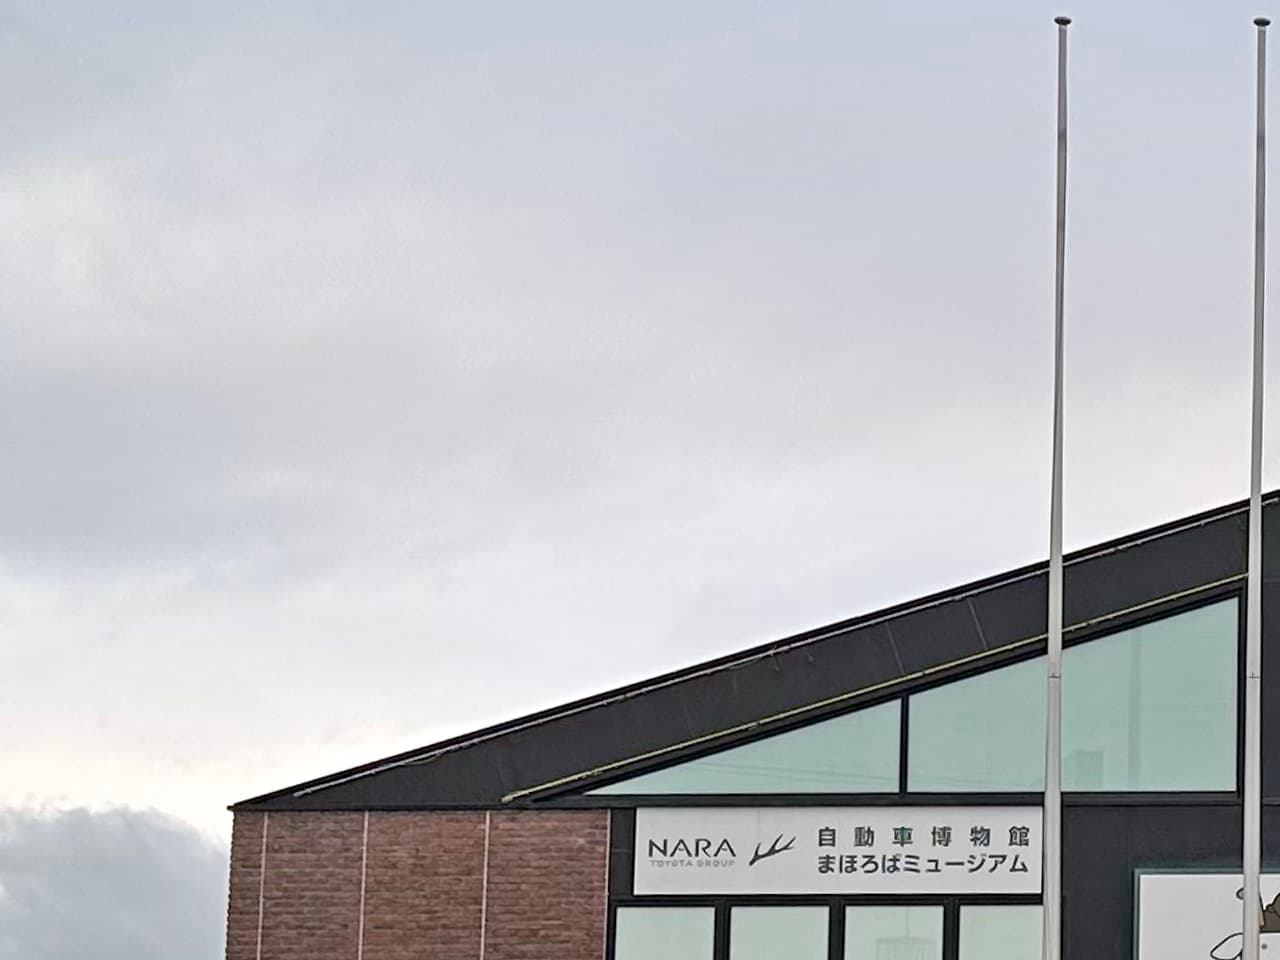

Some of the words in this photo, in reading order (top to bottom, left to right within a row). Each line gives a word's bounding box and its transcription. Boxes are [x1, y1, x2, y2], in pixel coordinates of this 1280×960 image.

[817, 826, 1030, 848] 自動車博物館
[648, 838, 737, 858] NARA
[648, 860, 694, 868] TOYOTA
[696, 860, 736, 868] GROUP
[817, 853, 1029, 875] まほろばミュージアム
